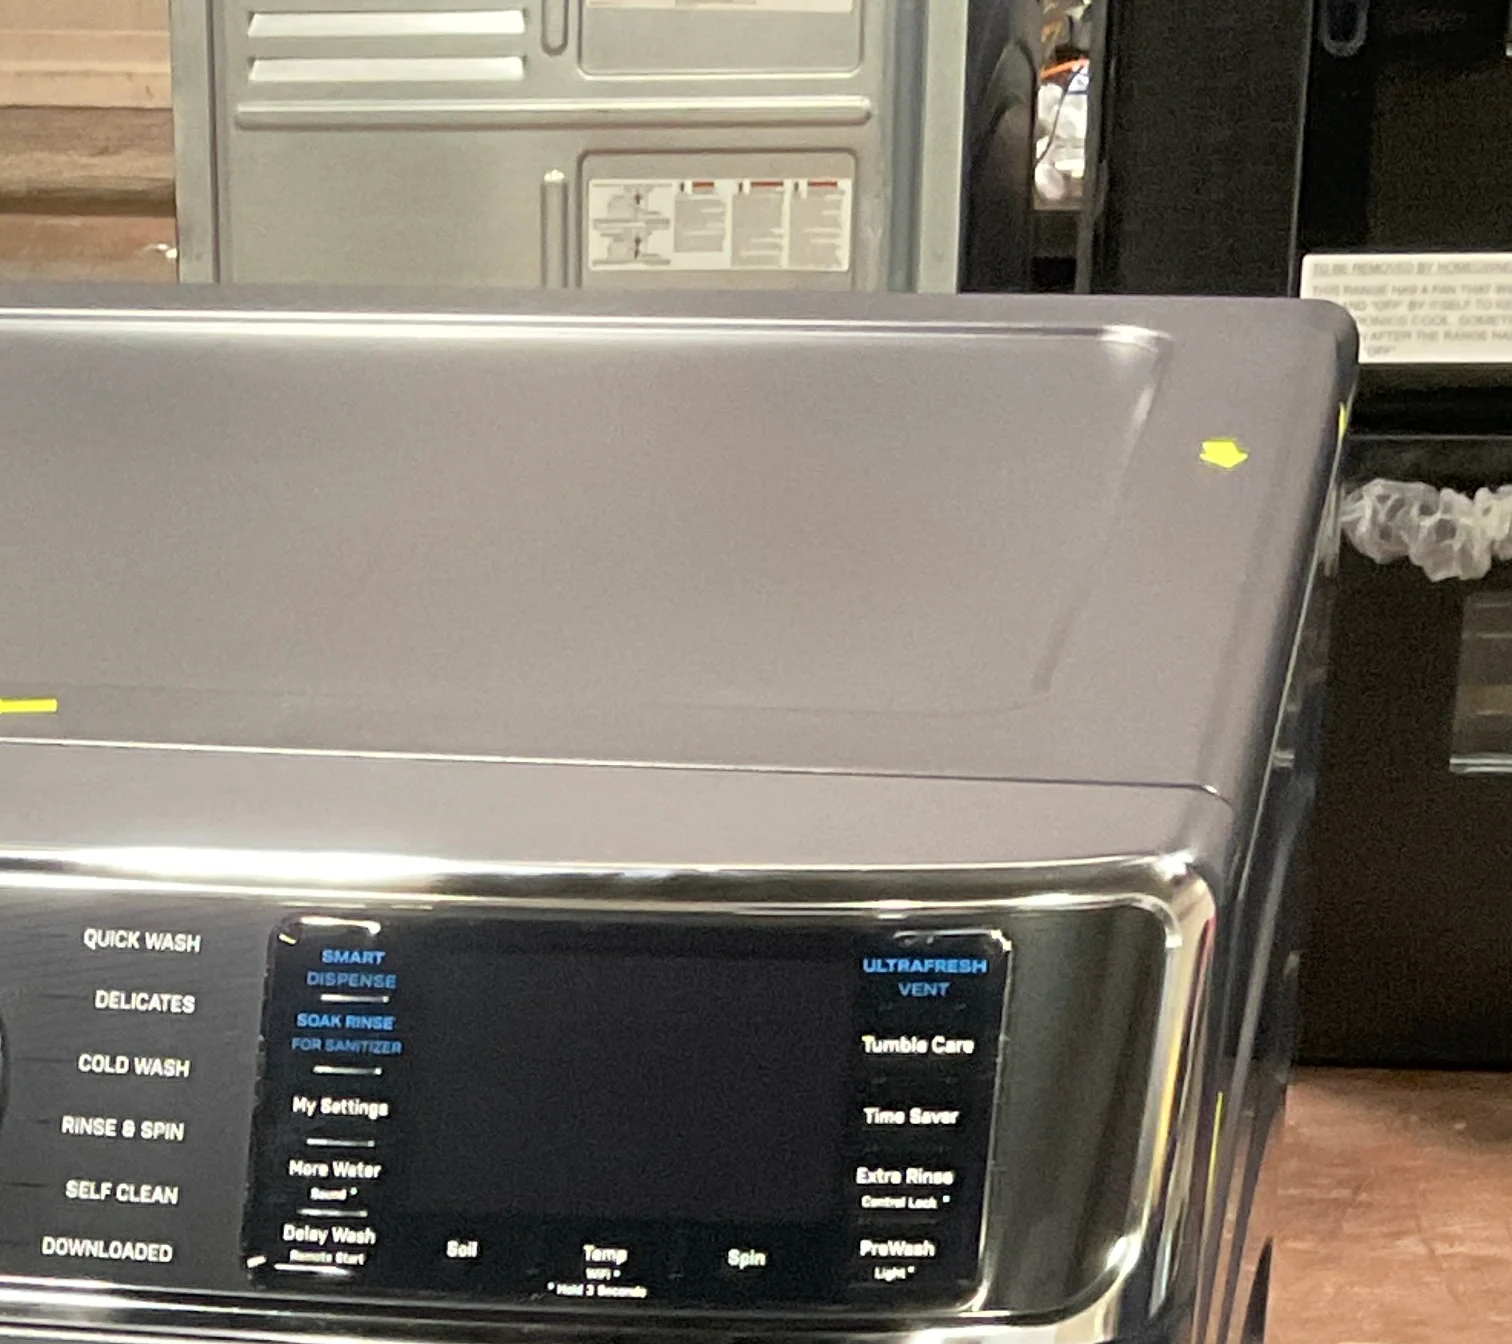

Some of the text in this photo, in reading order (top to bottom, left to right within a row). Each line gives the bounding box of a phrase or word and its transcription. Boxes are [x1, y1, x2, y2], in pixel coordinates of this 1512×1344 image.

[83, 928, 201, 953] QUICK WASH
[322, 949, 386, 965] SMART
[862, 957, 987, 974] ULTRAFRESH
[306, 971, 397, 990] DISPENSE
[898, 981, 951, 997] VENT
[95, 989, 196, 1014] DELICATES
[296, 1013, 395, 1031] SOAK RINSE
[291, 1037, 403, 1054] FOR SANITIZER
[861, 1034, 976, 1054] Tumble Care
[78, 1053, 190, 1078] COLD WASH
[292, 1096, 389, 1120] My Settings
[863, 1106, 960, 1125] Time Saver
[61, 1115, 185, 1141] RINSE & SPIN
[289, 1160, 382, 1179] More Water
[856, 1166, 955, 1186] Extra Rinse
[65, 1179, 179, 1205] SELF CLEAN
[283, 1223, 377, 1246] Delay Wash
[42, 1236, 174, 1263] DOWNLOADED
[446, 1239, 478, 1258] Soil
[583, 1244, 628, 1266] Temp
[859, 1239, 936, 1257] PreWash
[727, 1248, 766, 1270] Spin
